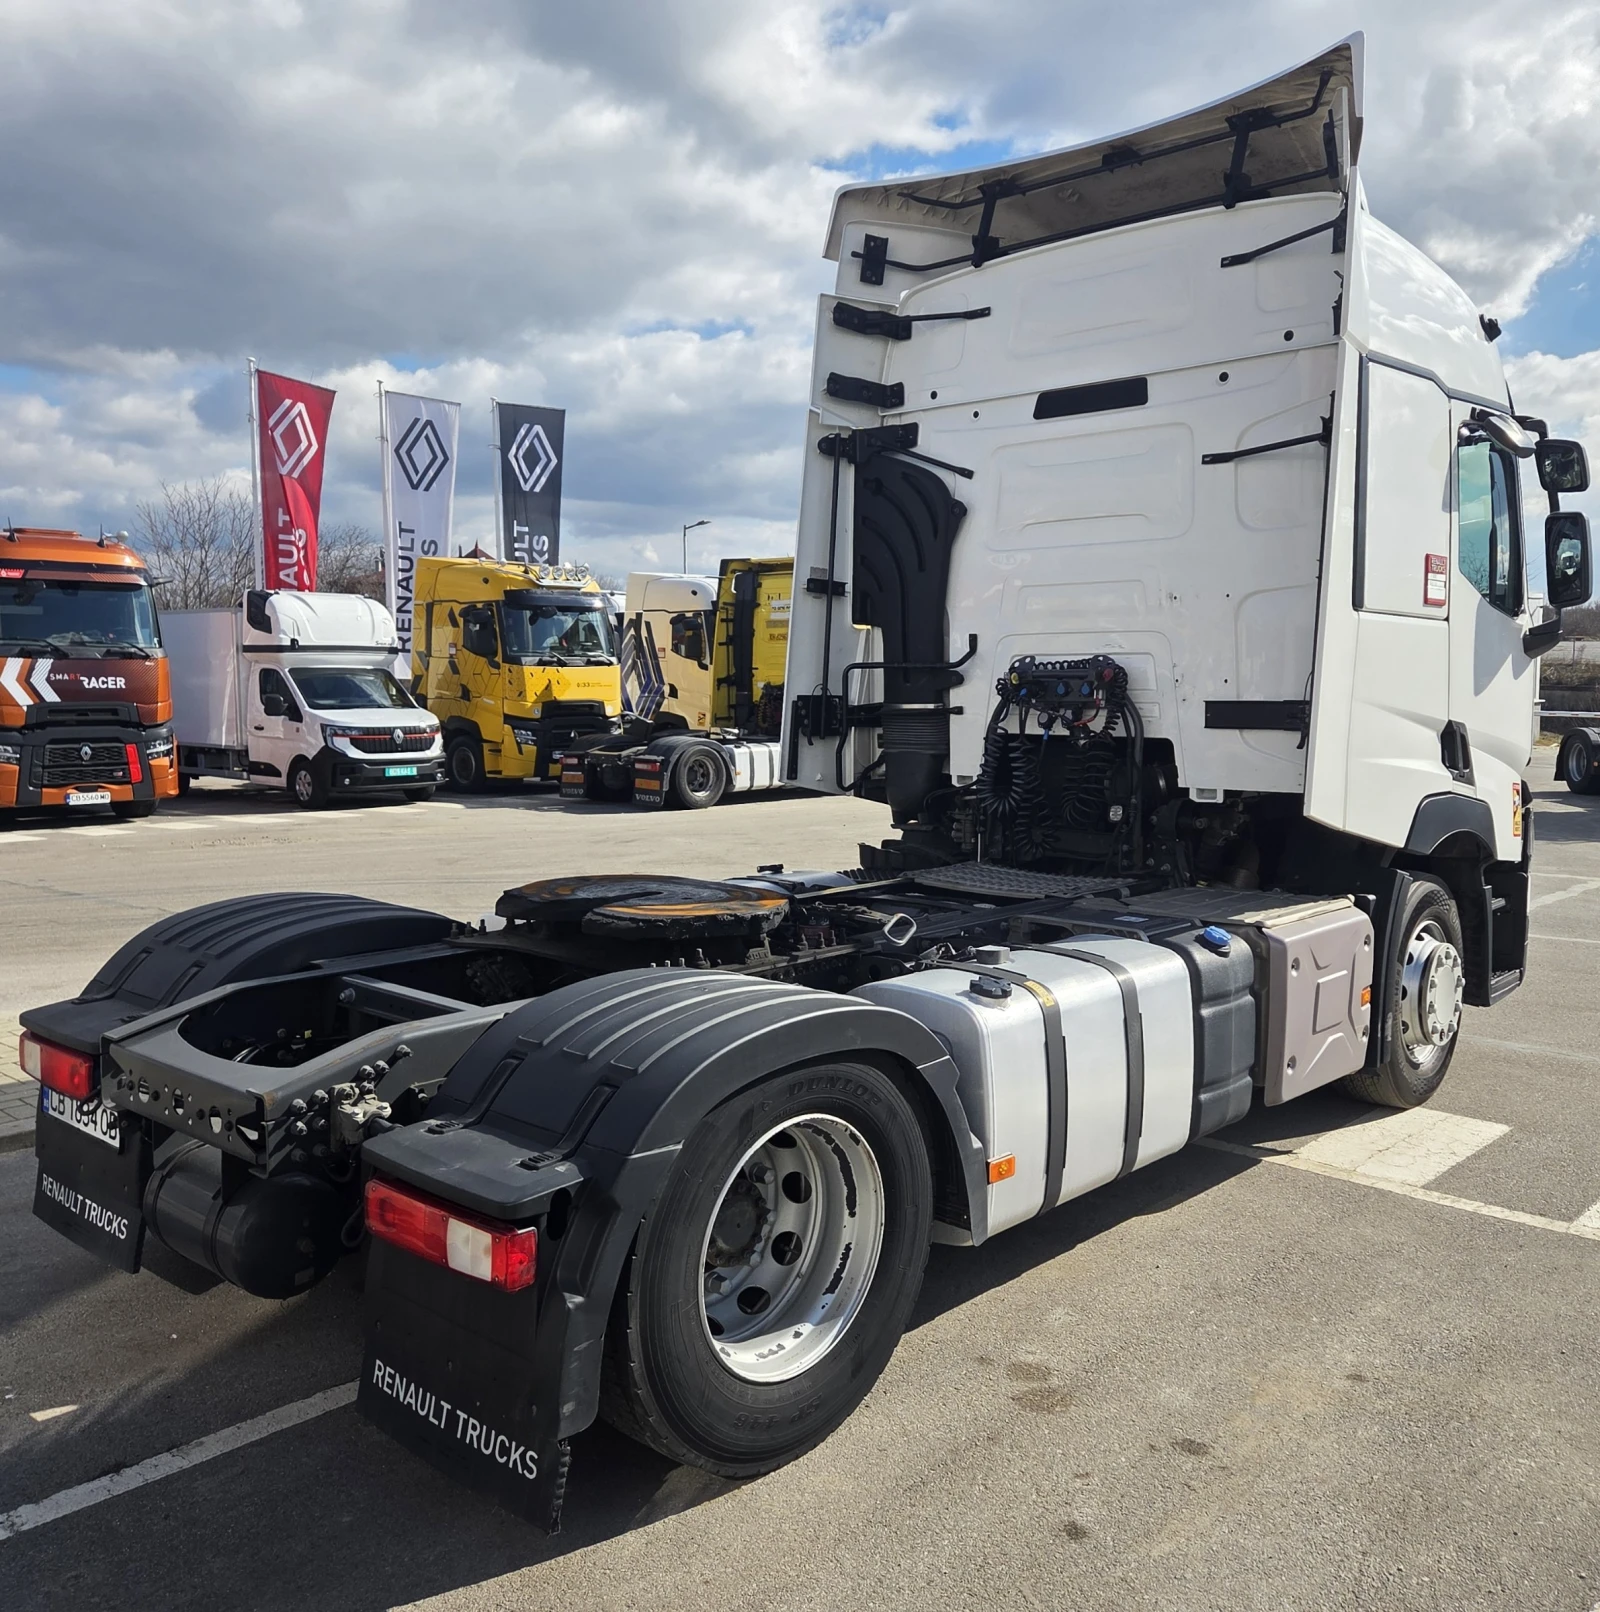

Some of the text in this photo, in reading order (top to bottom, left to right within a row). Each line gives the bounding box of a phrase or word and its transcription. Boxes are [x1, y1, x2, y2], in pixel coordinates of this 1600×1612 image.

[396, 521, 415, 653] RENAULT
[49, 673, 126, 689] SMART RACER
[635, 793, 661, 803] VOLVO
[787, 1075, 881, 1107] DUNLOP
[41, 1172, 128, 1240] RENAULT TRUCKS
[372, 1358, 539, 1480] RENAULT TRUCKS
